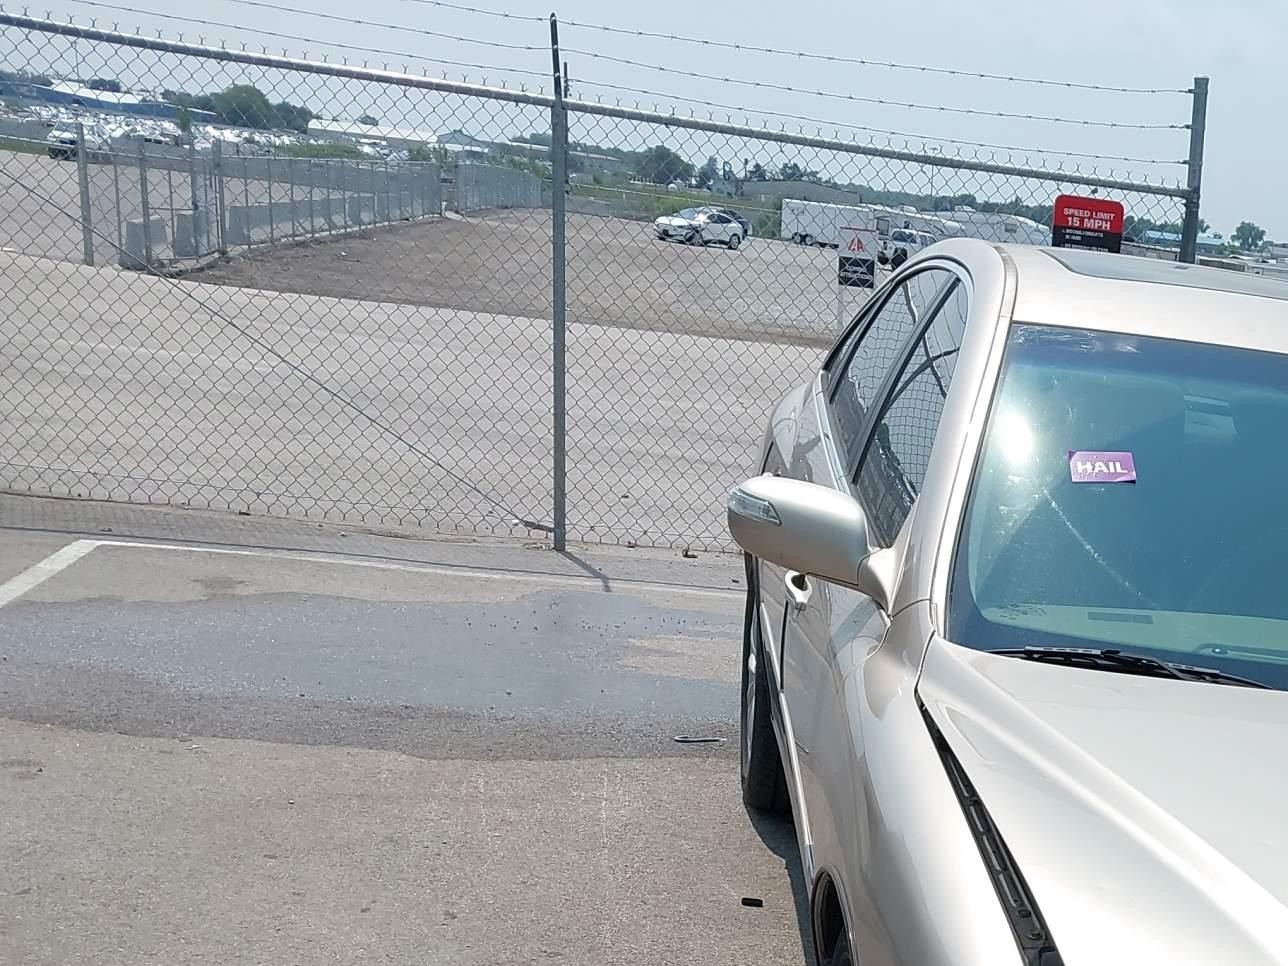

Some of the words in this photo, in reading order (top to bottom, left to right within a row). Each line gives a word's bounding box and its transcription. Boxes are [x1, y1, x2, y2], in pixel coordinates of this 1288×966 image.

[1063, 208, 1091, 217] SPEED
[1092, 211, 1116, 220] LIMIT
[1067, 216, 1080, 227] 15
[1083, 219, 1111, 231] MPH
[1076, 460, 1129, 474] HAIL
